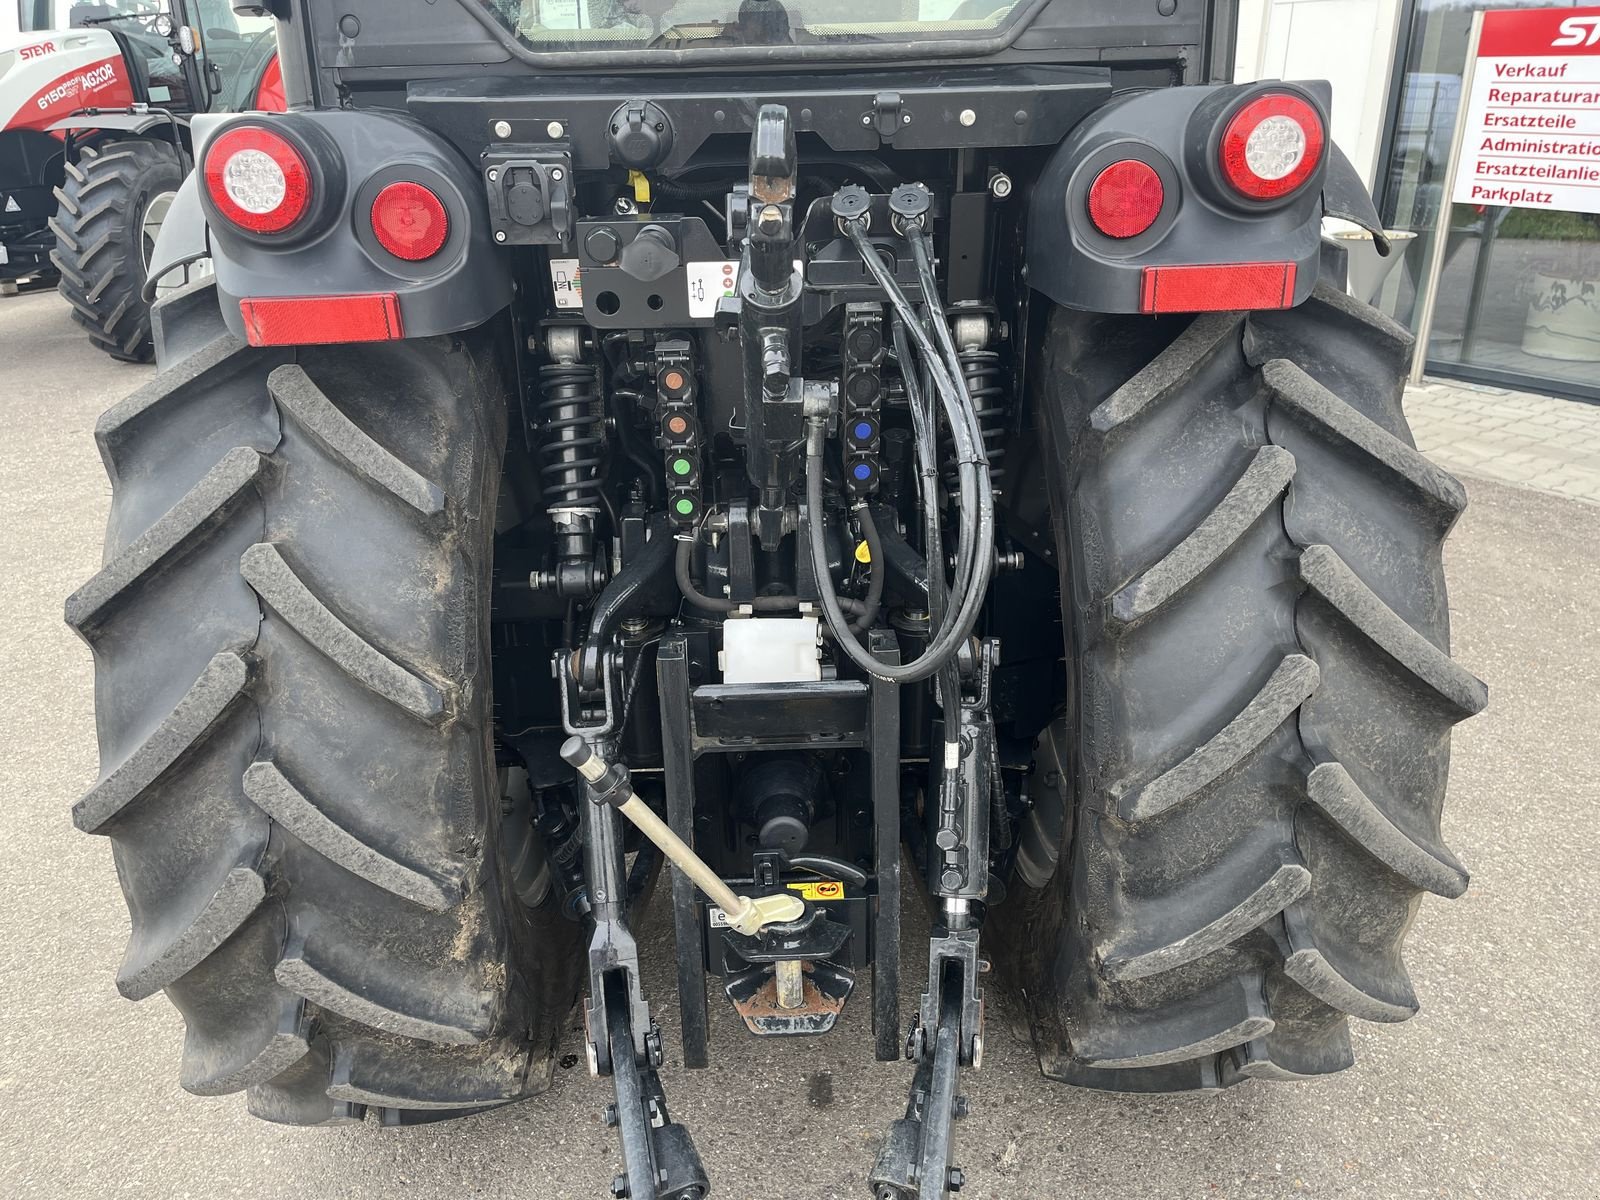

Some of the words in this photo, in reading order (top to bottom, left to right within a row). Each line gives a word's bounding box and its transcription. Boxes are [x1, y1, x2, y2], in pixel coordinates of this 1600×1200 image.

[20, 41, 56, 60] STEYR
[80, 63, 115, 91] AGXOR
[1495, 63, 1568, 77] Verkauf
[37, 86, 66, 110] 6150
[1484, 113, 1576, 128] Ersatzteile
[1480, 138, 1600, 155] Administratio
[1476, 161, 1600, 180] Ersatzteilanlie
[1471, 186, 1553, 204] Parkplatz
